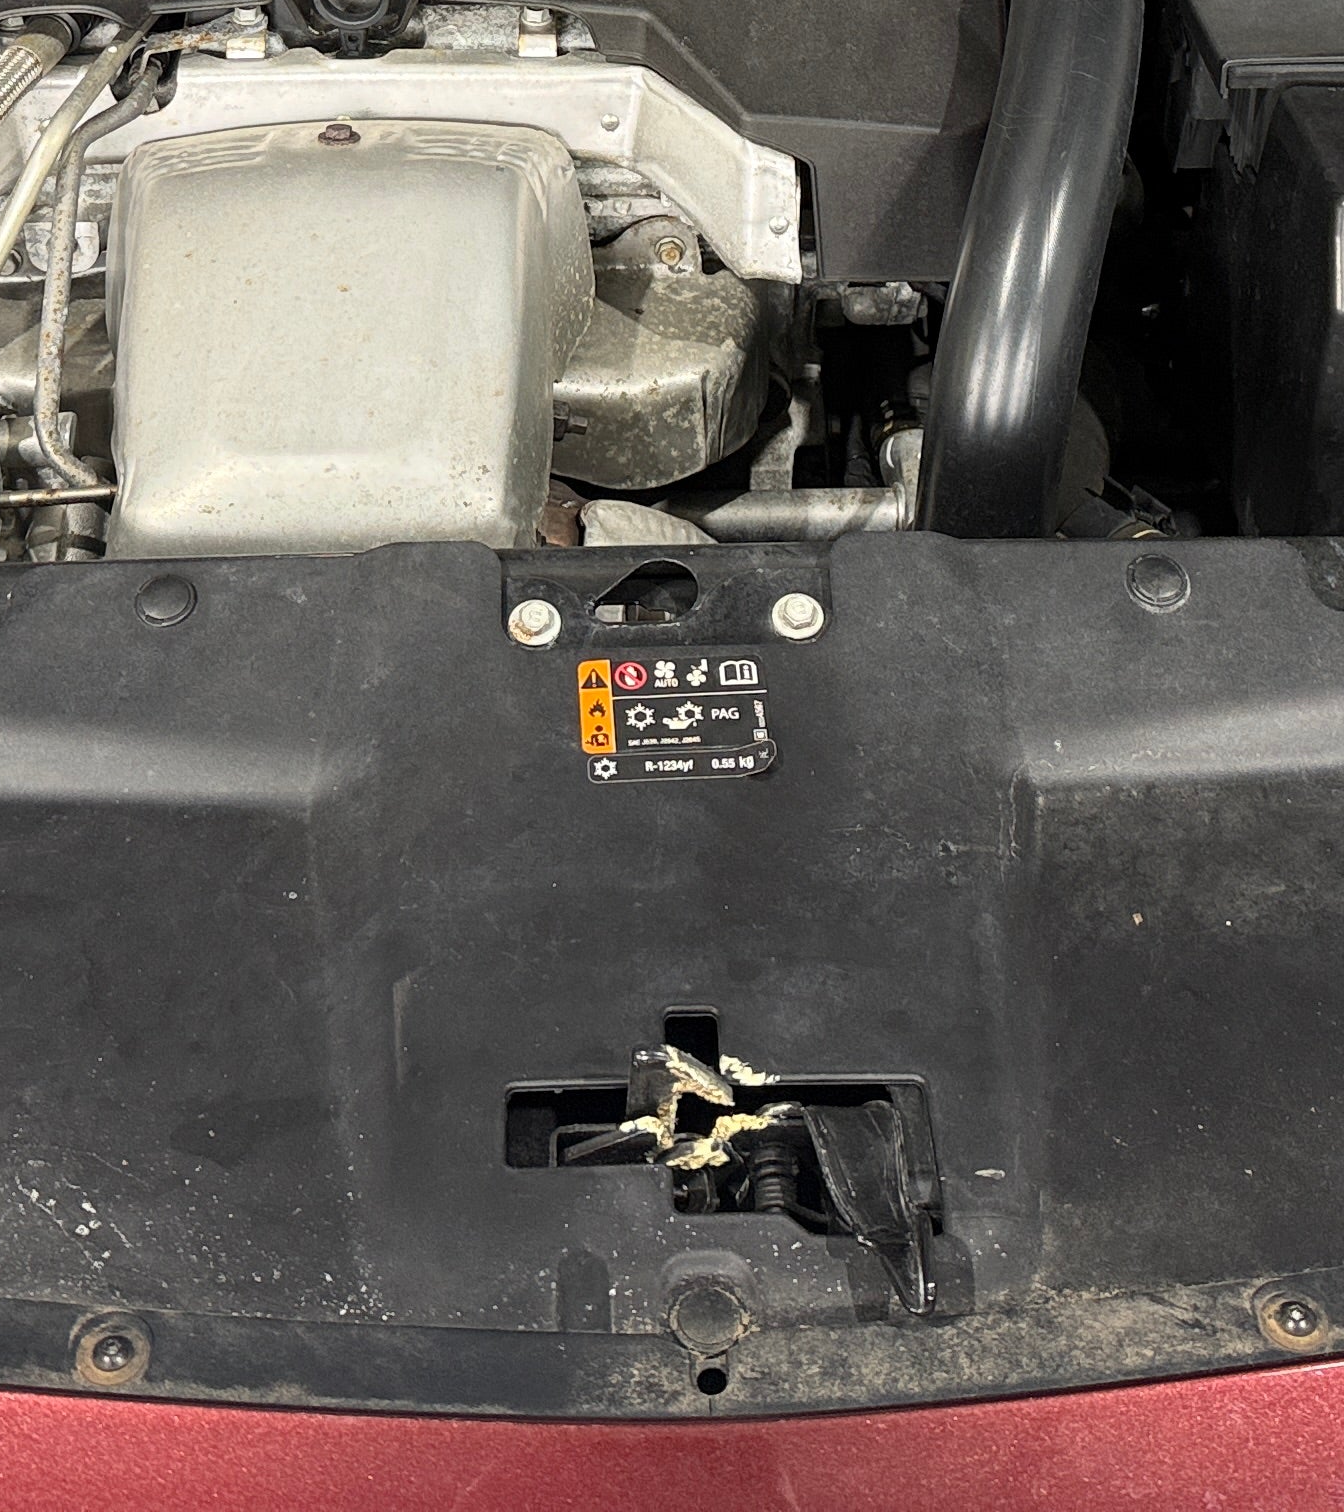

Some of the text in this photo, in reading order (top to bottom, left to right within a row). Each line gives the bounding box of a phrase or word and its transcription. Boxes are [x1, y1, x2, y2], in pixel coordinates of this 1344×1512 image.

[654, 678, 679, 688] AUTO
[711, 707, 740, 720] PAG
[644, 754, 755, 773] R-1234yf 0.55 kg
